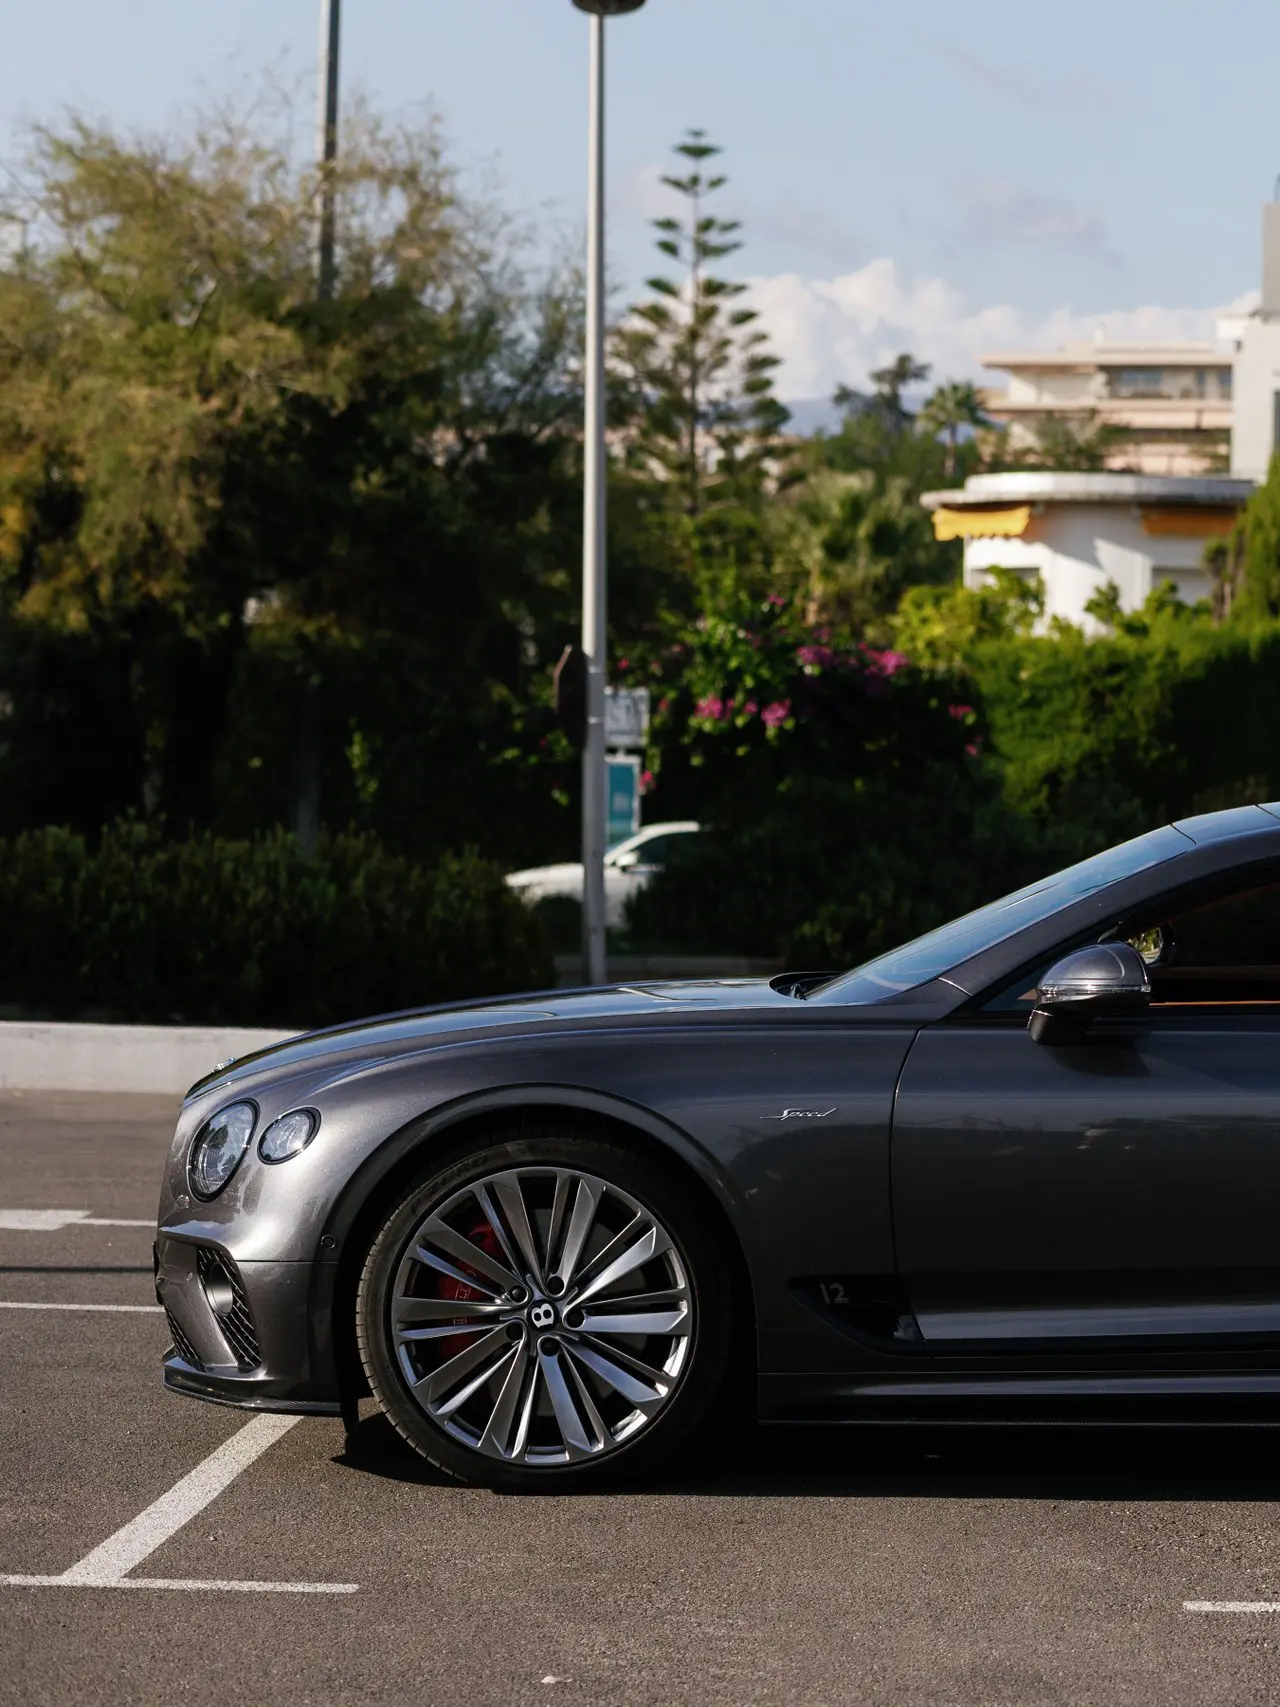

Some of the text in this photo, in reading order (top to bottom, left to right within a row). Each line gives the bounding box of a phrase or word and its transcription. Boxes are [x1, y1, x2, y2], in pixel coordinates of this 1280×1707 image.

[760, 1107, 837, 1121] Speed
[819, 1282, 849, 1304] 12
[531, 1303, 555, 1329] B
